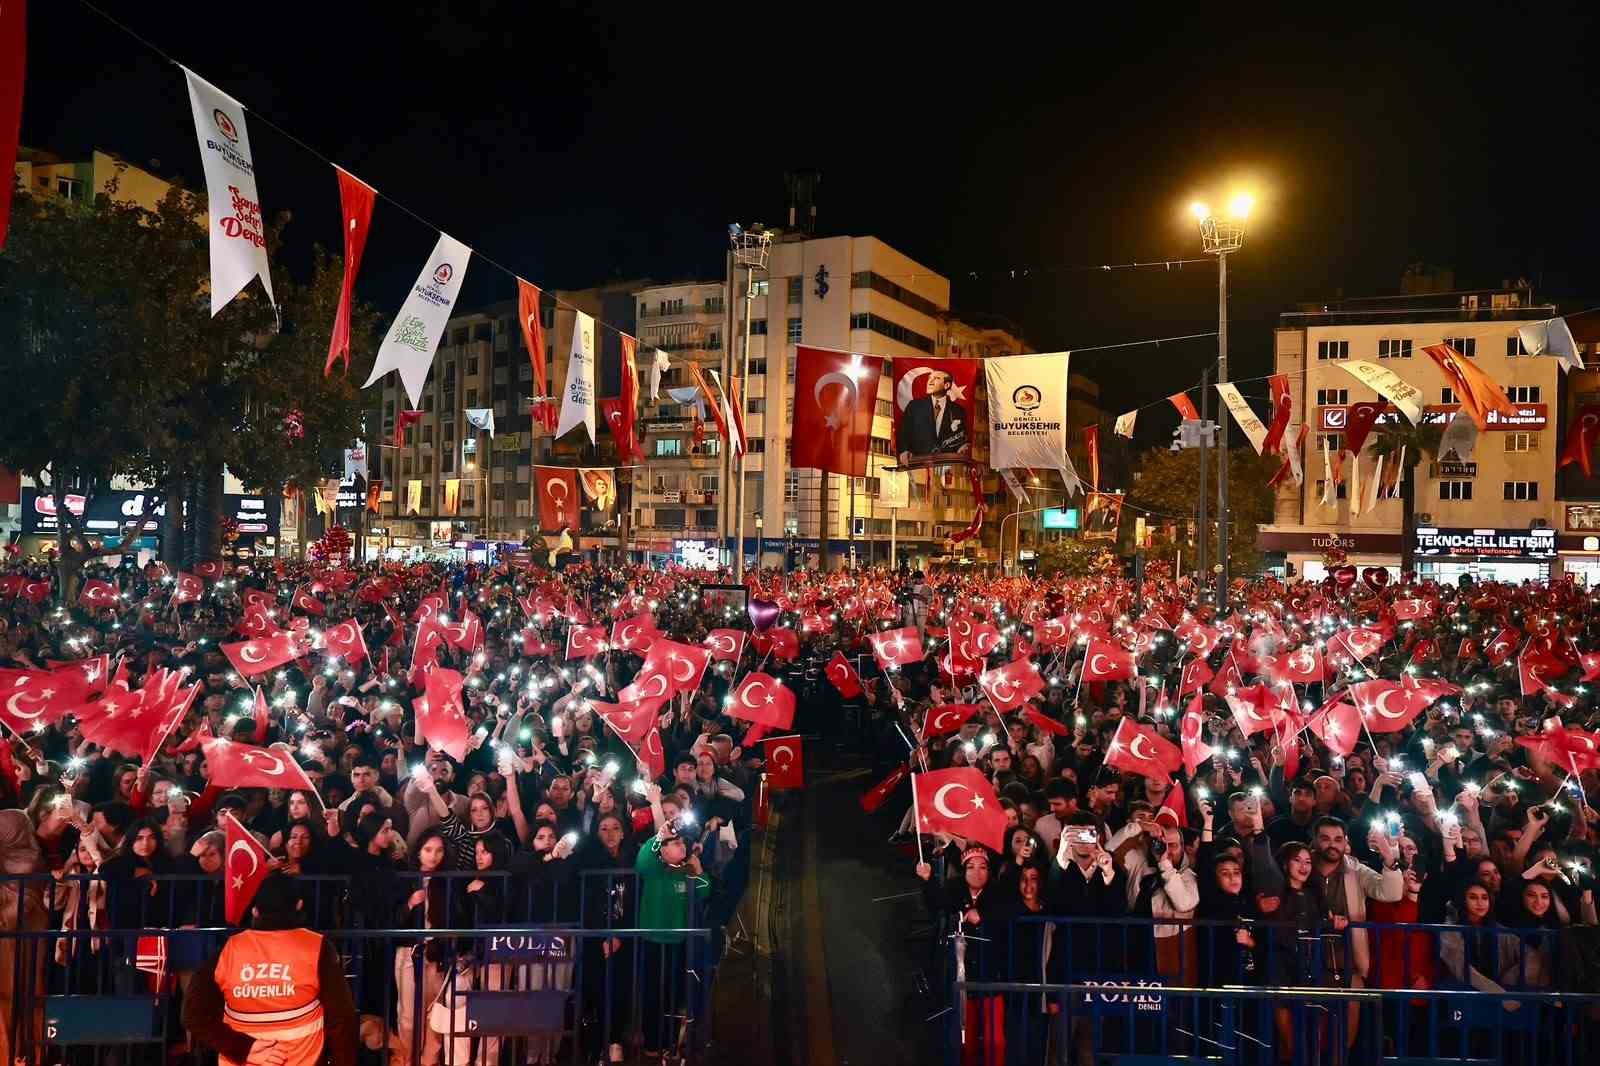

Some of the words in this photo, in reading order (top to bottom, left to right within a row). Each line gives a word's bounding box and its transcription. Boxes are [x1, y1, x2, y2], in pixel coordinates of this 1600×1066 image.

[1312, 538, 1356, 548] TUDORS
[1417, 535, 1497, 547] TEKNO-CELL
[240, 962, 293, 982] ÖZEL
[232, 983, 296, 998] GÜVENLİK
